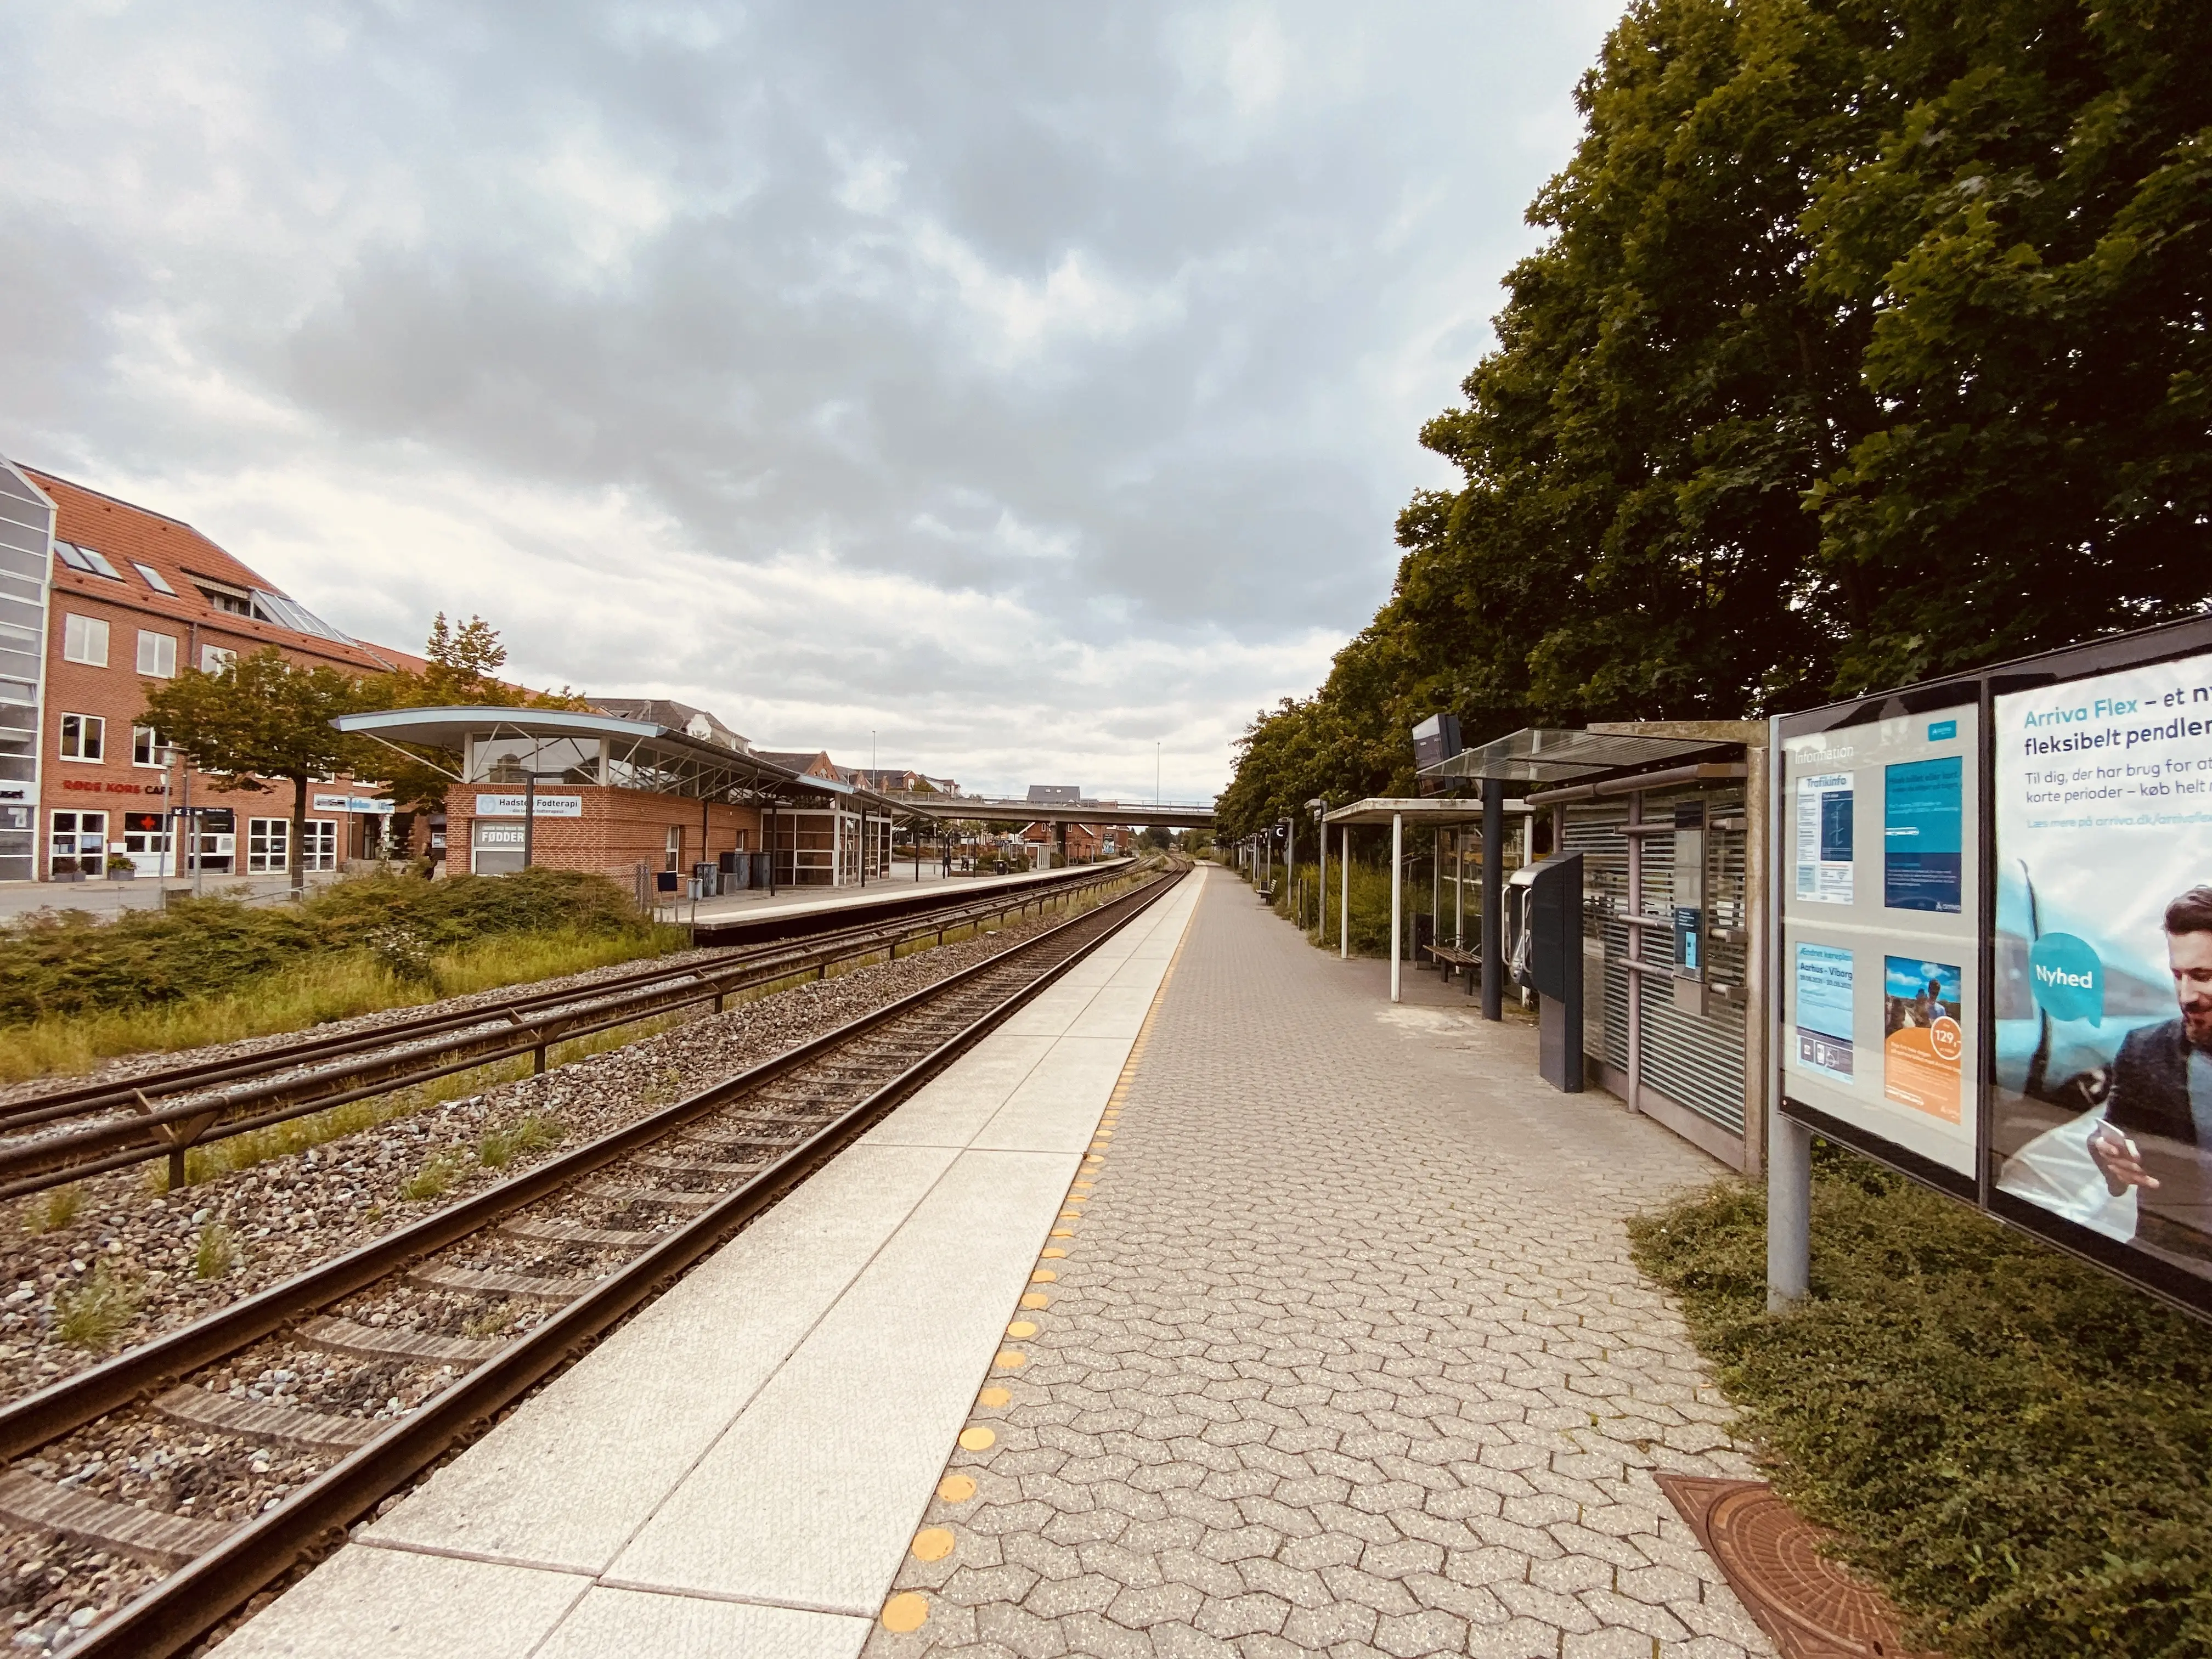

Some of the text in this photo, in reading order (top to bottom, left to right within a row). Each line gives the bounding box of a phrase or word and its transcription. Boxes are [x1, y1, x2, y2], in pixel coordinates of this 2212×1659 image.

[2024, 706, 2087, 729] Arriva
[2094, 698, 2138, 718] Flex
[2164, 687, 2185, 707] et
[2193, 686, 2212, 703] n
[2024, 728, 2121, 755] fleksibelt
[1795, 746, 1854, 765] Information
[1806, 775, 1847, 788] Trafikinfo
[2025, 772, 2040, 785] Til
[2045, 771, 2068, 785] dig,
[2073, 768, 2094, 781] der
[2097, 766, 2123, 779] har
[2126, 763, 2160, 777] brug
[2164, 759, 2192, 773] for
[2026, 791, 2061, 804] korte
[2064, 786, 2123, 804] perioder
[2140, 782, 2170, 796] køb
[2175, 778, 2205, 794] helt
[537, 799, 578, 809] Fodterapi
[2078, 815, 2092, 828] på
[481, 831, 525, 843] FØDDER
[1276, 827, 1284, 837] C
[1801, 962, 1824, 974] Aarhus
[1829, 966, 1853, 981] Viborg
[2035, 964, 2092, 989] Nyhed
